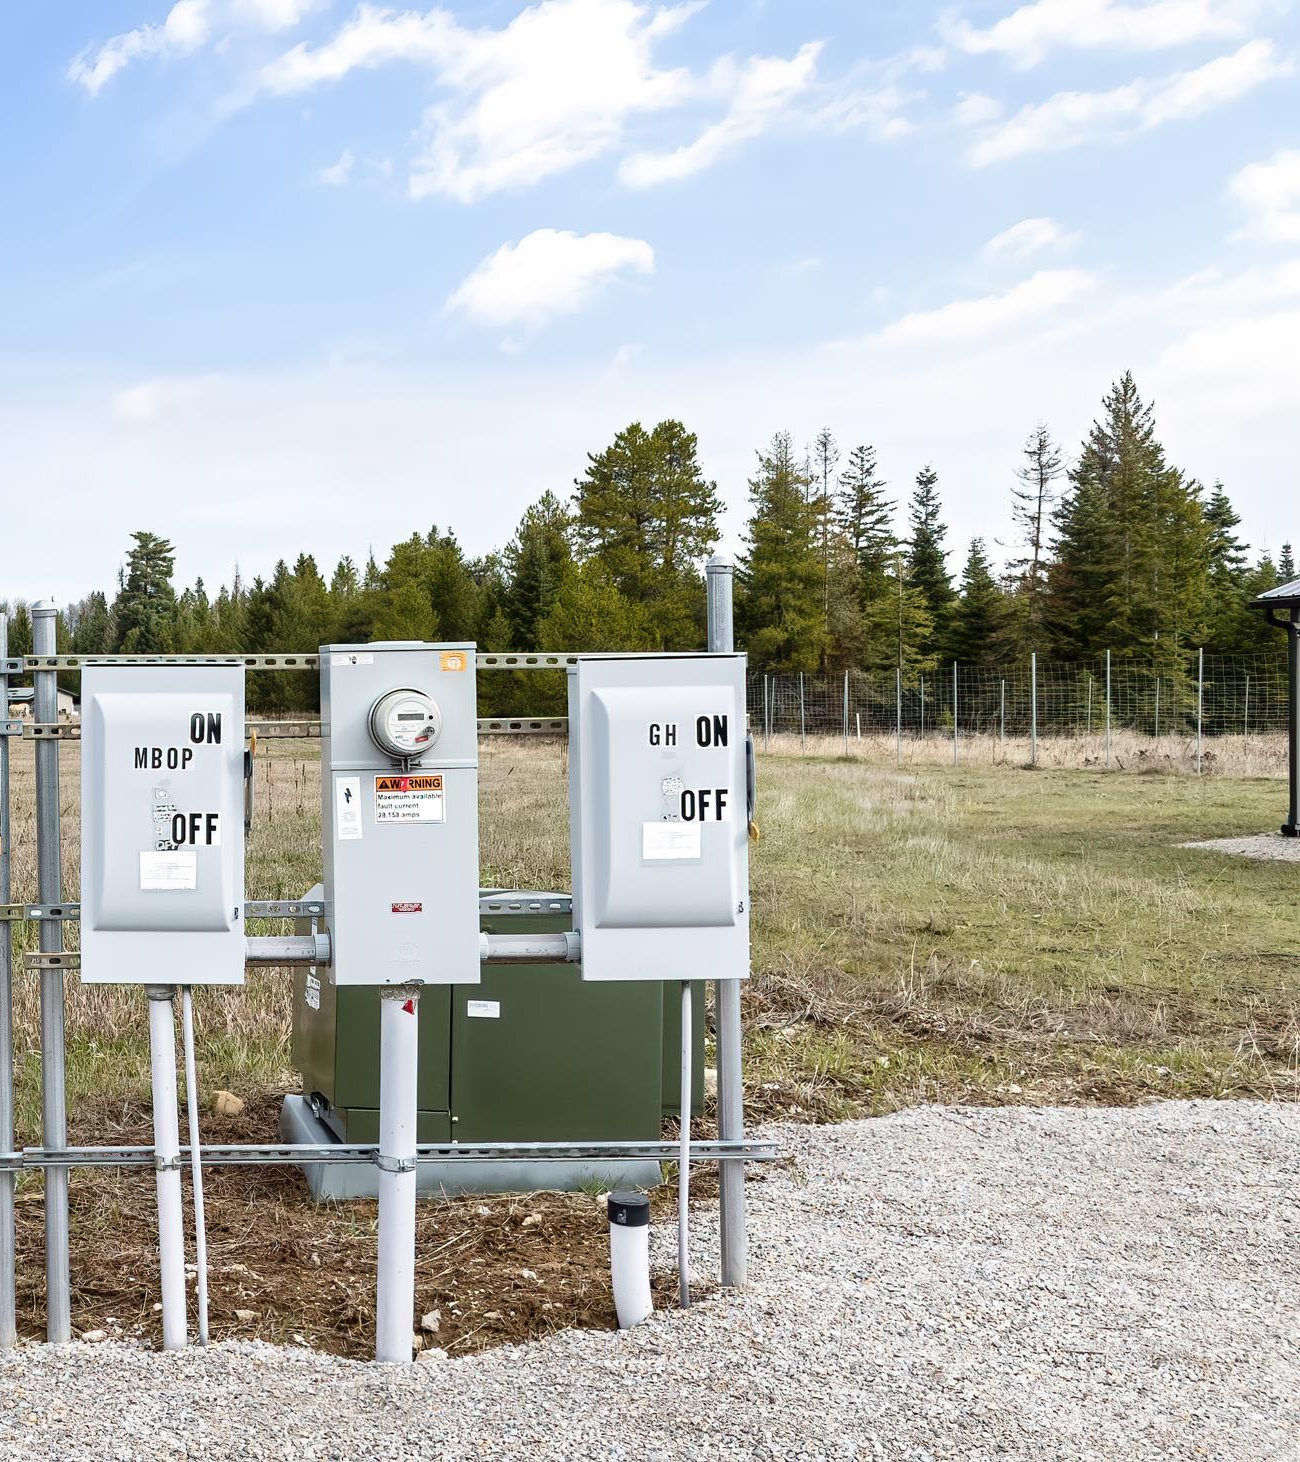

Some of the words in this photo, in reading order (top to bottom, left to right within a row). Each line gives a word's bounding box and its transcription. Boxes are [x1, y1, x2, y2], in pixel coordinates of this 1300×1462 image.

[191, 713, 221, 744] ON
[650, 724, 676, 745] GH
[697, 715, 727, 747] ON
[135, 748, 192, 769] MBOP
[390, 779, 440, 788] WRNING
[681, 790, 727, 821] OFF
[172, 813, 218, 845] OFF
